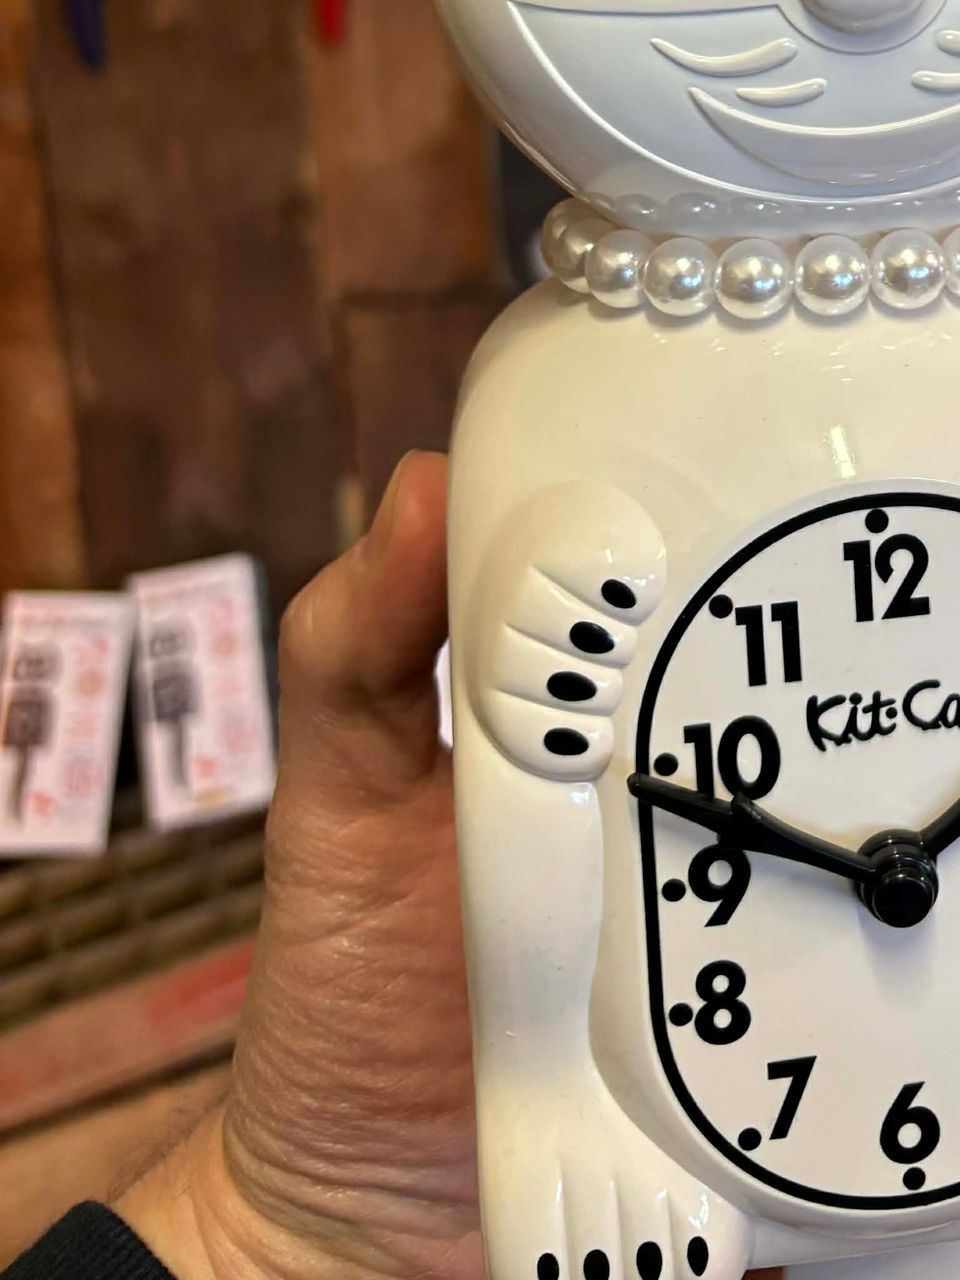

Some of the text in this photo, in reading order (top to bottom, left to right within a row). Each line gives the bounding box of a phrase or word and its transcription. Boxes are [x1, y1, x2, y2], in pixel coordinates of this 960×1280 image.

[844, 534, 930, 622] 12
[736, 600, 802, 686] 11
[684, 715, 780, 801] 10
[688, 840, 751, 928] 9
[695, 960, 751, 1045] 8
[767, 1056, 817, 1140] 7
[879, 1081, 940, 1165] 6
